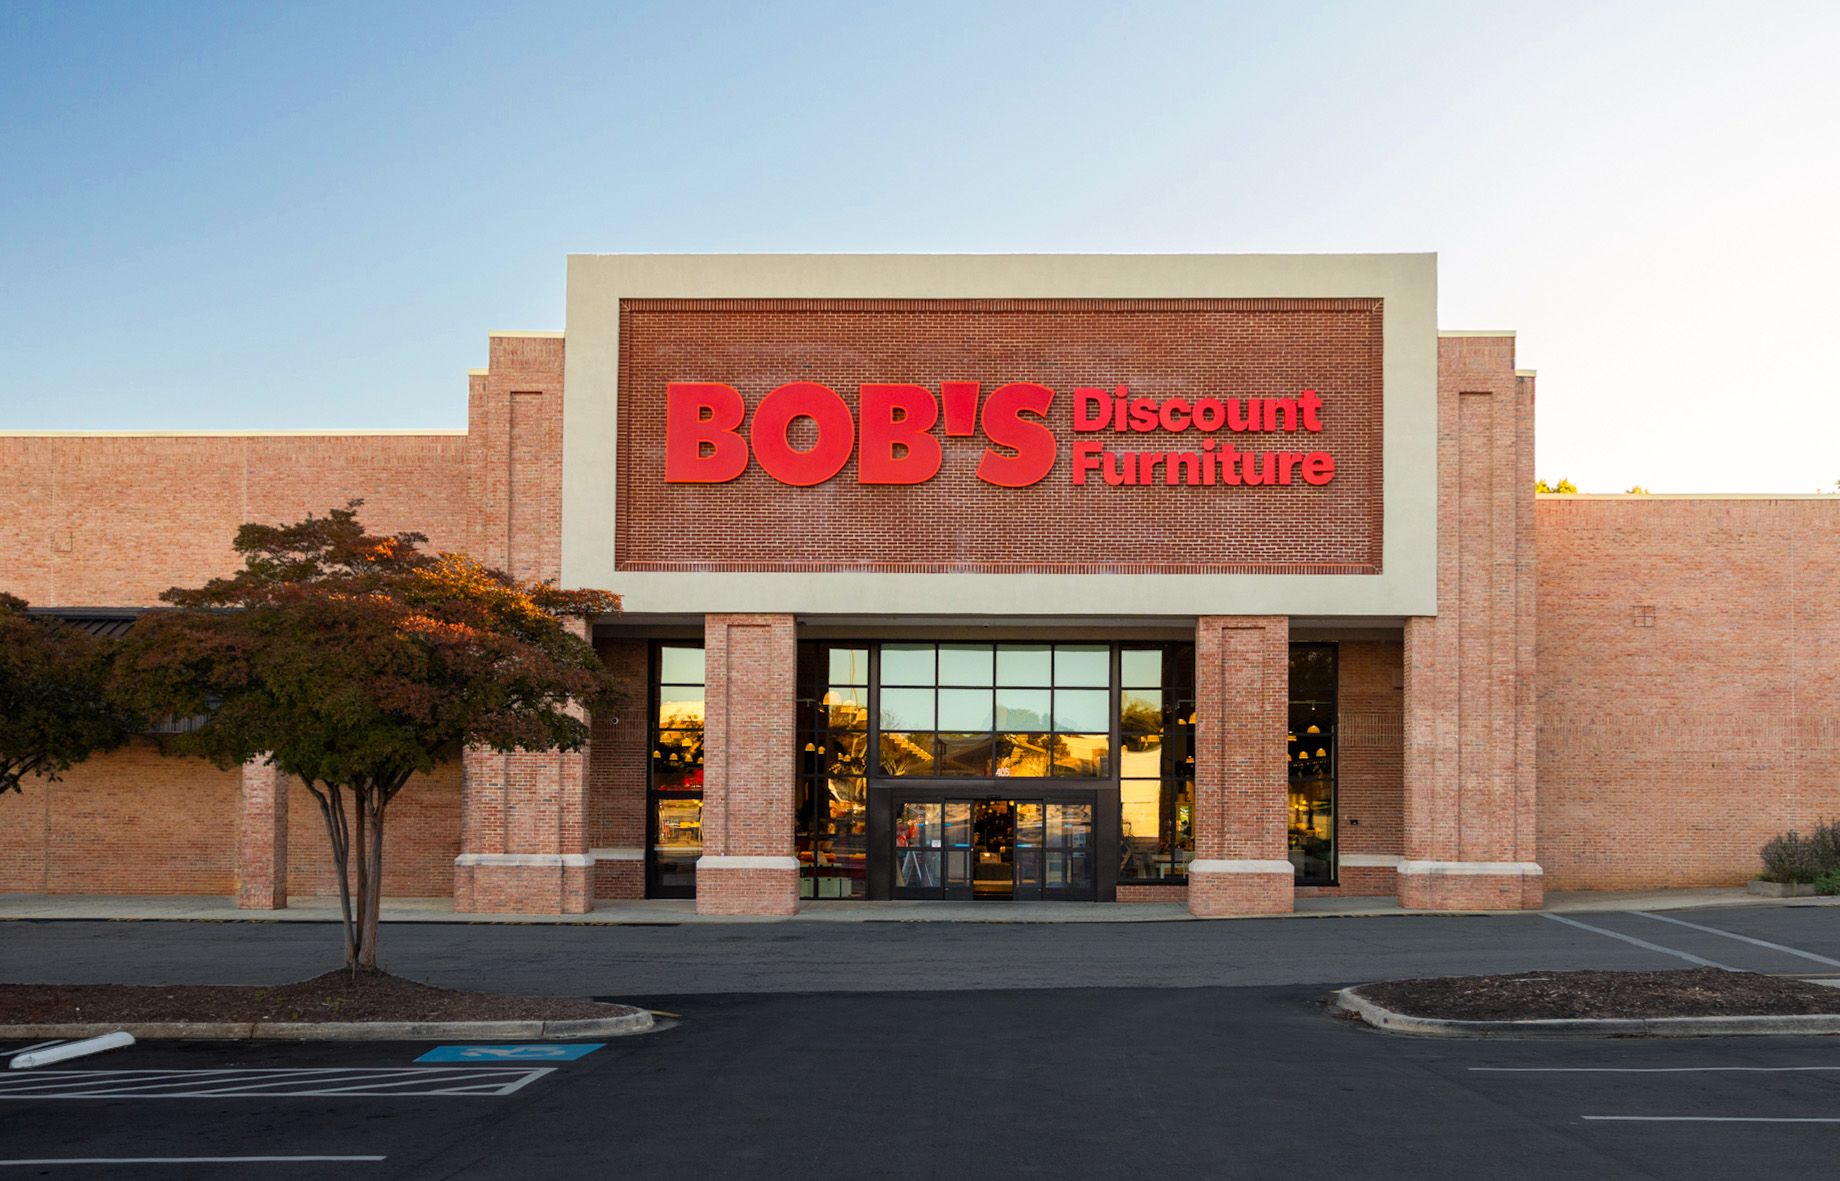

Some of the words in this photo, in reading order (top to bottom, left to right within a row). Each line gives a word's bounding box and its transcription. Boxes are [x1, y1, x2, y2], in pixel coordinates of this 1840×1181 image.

[1073, 385, 1323, 433] Discount
[665, 380, 1058, 487] BOB'S
[1072, 438, 1336, 486] Furniture
[995, 767, 1010, 777] 405
